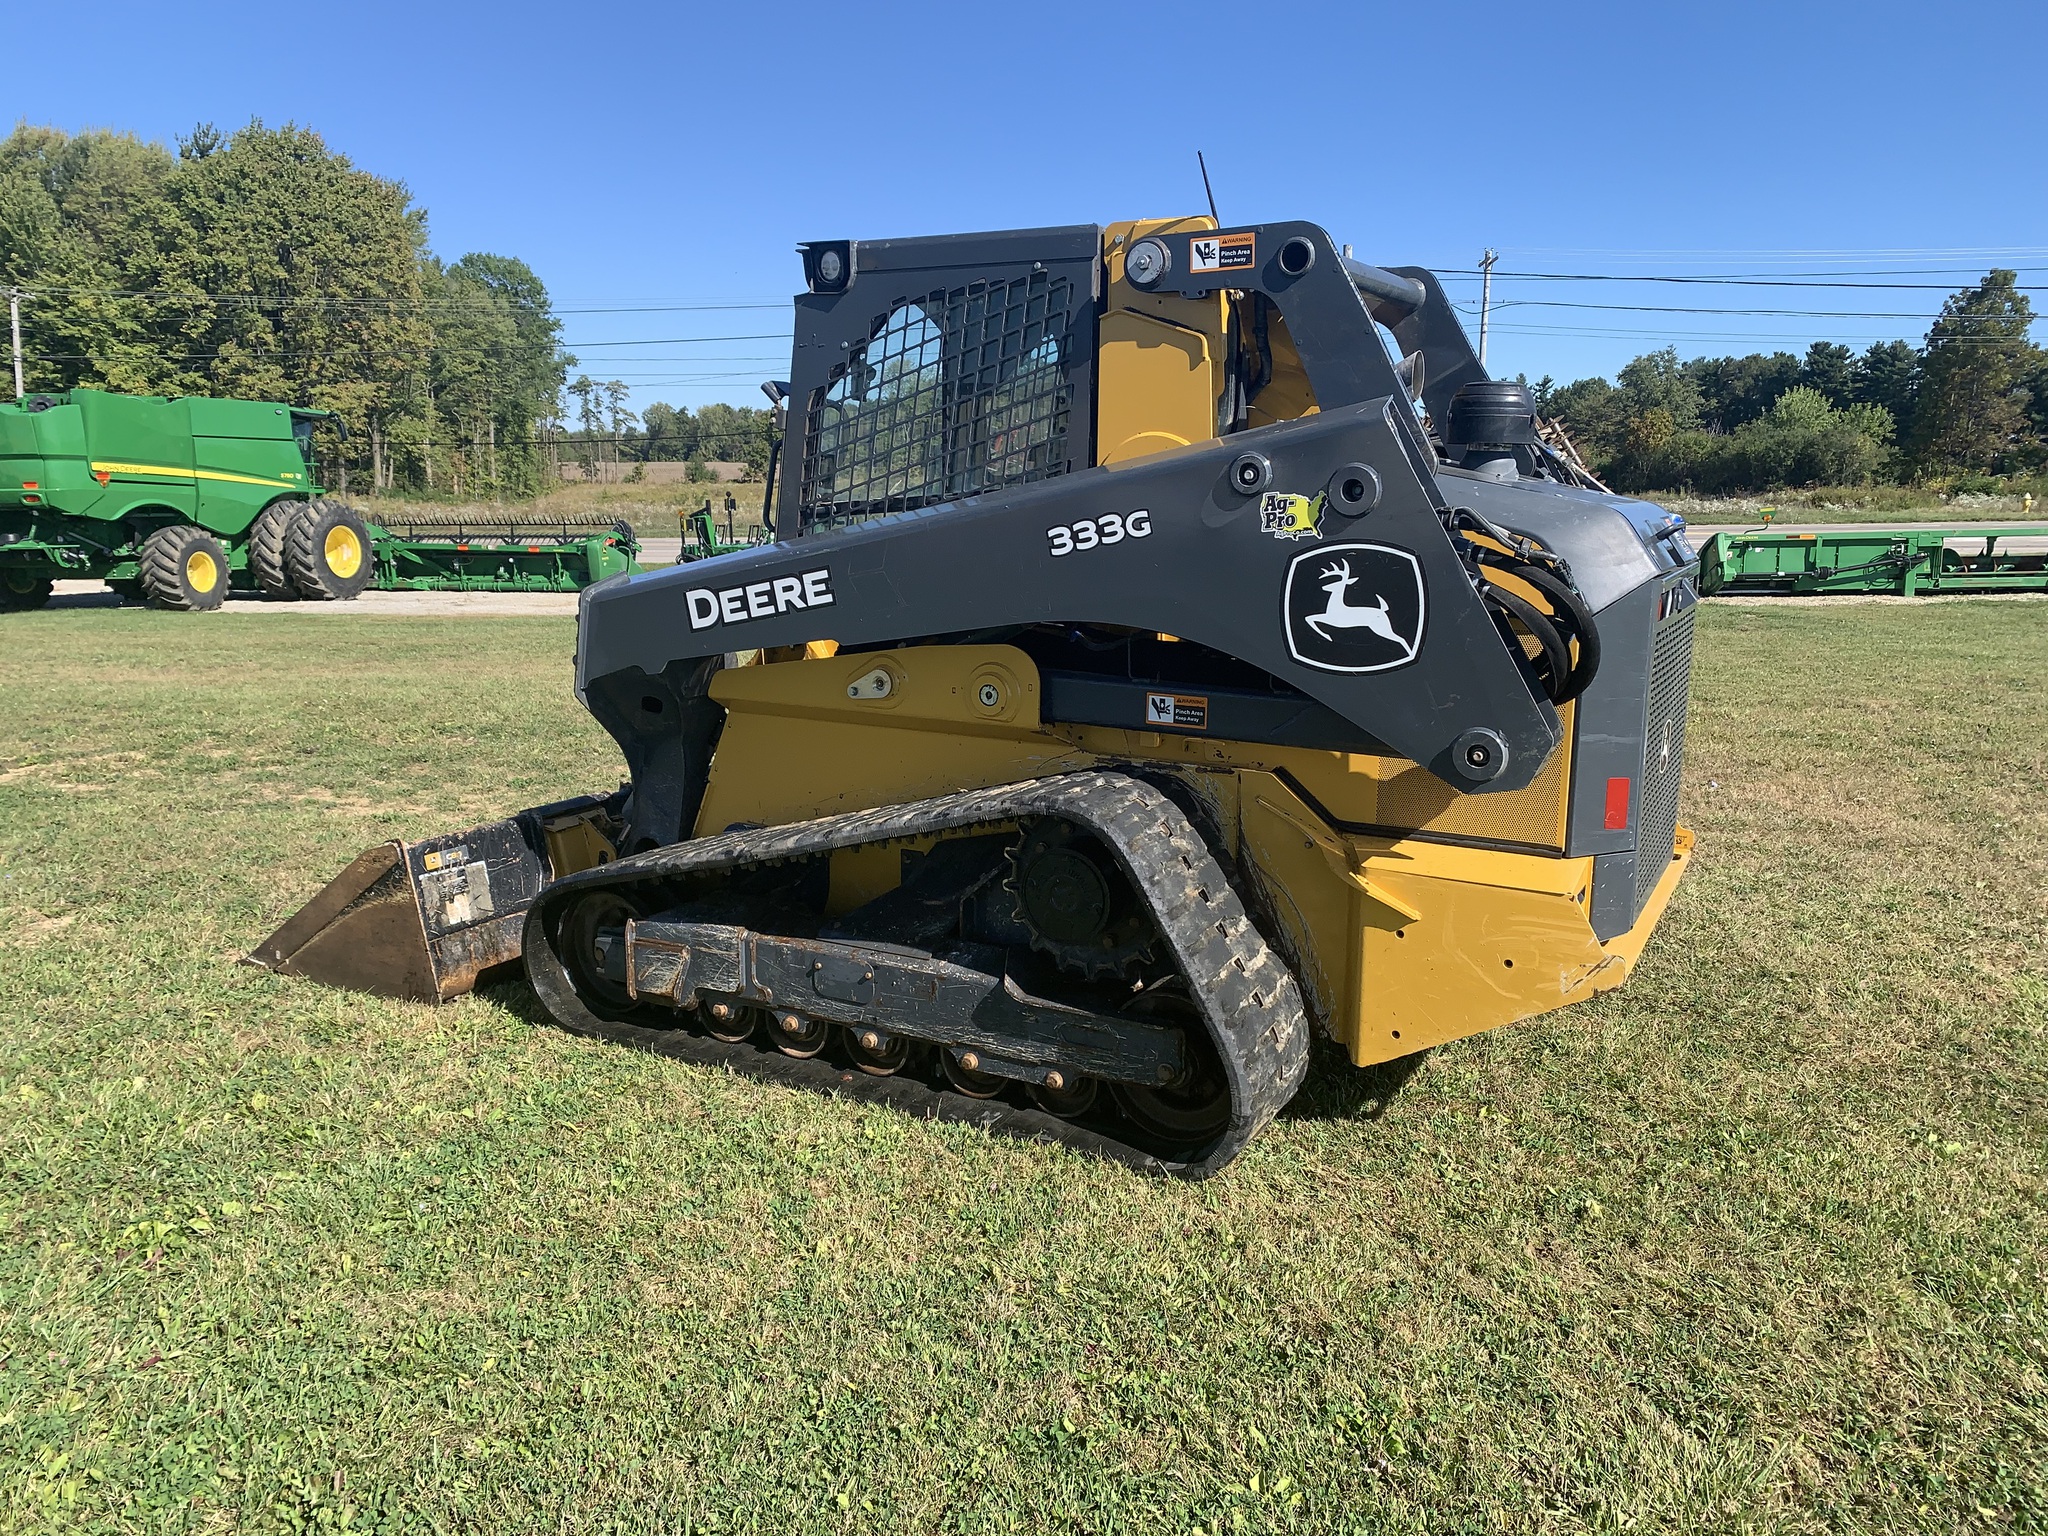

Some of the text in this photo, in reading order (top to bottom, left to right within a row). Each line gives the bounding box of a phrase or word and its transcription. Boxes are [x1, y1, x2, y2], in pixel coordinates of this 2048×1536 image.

[1264, 495, 1295, 514] Ag-
[1047, 510, 1152, 556] 333G
[1265, 513, 1296, 529] Pro
[685, 569, 834, 629] DEERE
